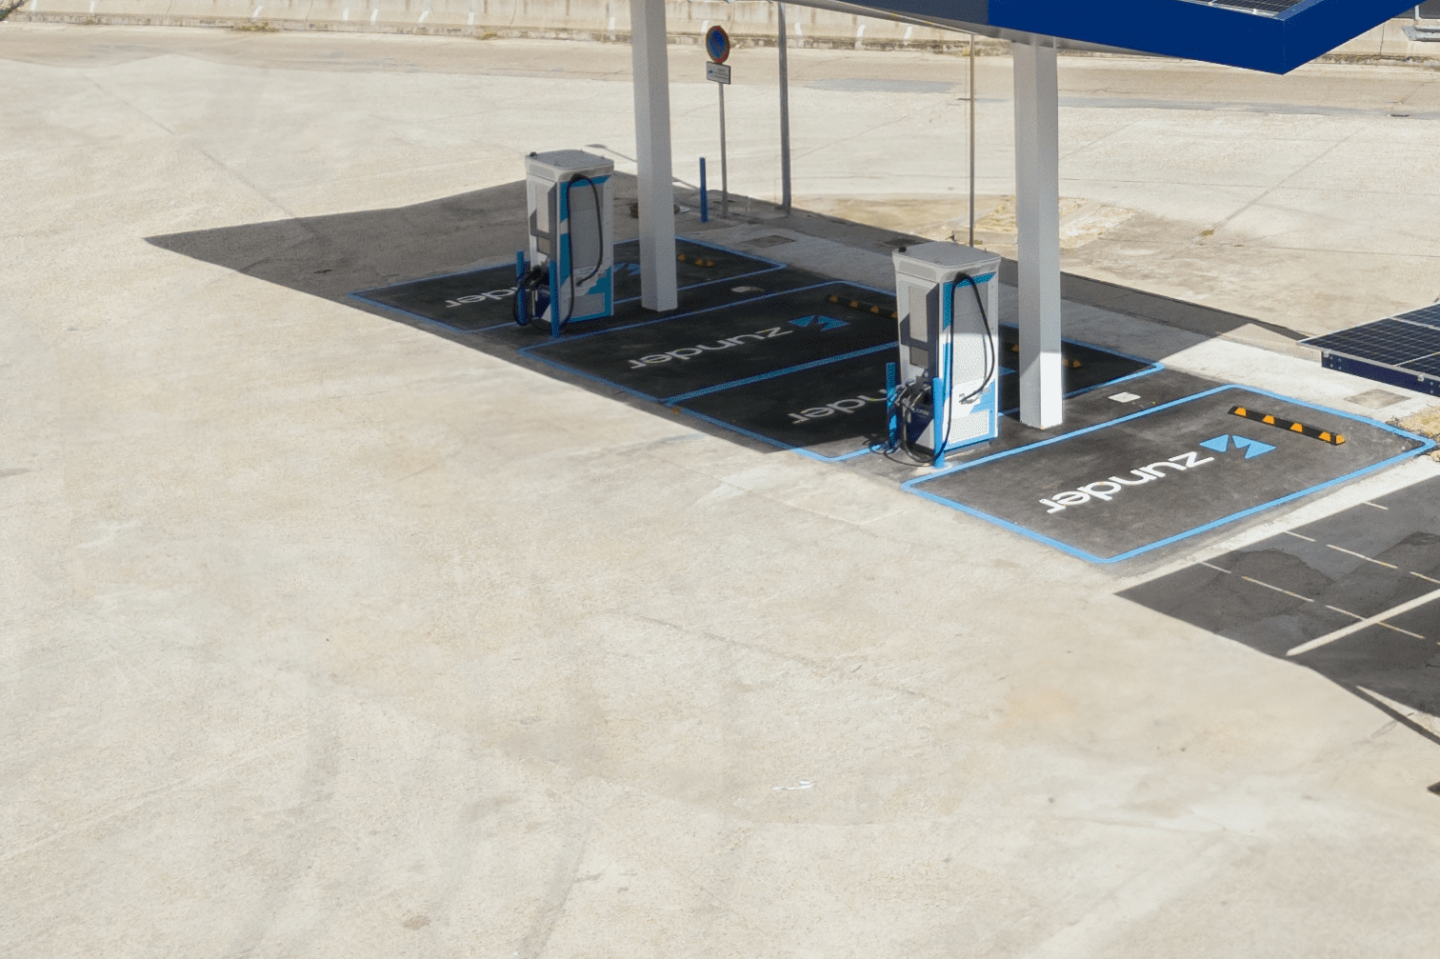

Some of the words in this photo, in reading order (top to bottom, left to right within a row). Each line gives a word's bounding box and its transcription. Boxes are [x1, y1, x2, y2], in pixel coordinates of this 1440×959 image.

[445, 286, 519, 308] der
[628, 326, 794, 369] zunder
[788, 388, 890, 424] nder
[1039, 451, 1215, 514] zunder
